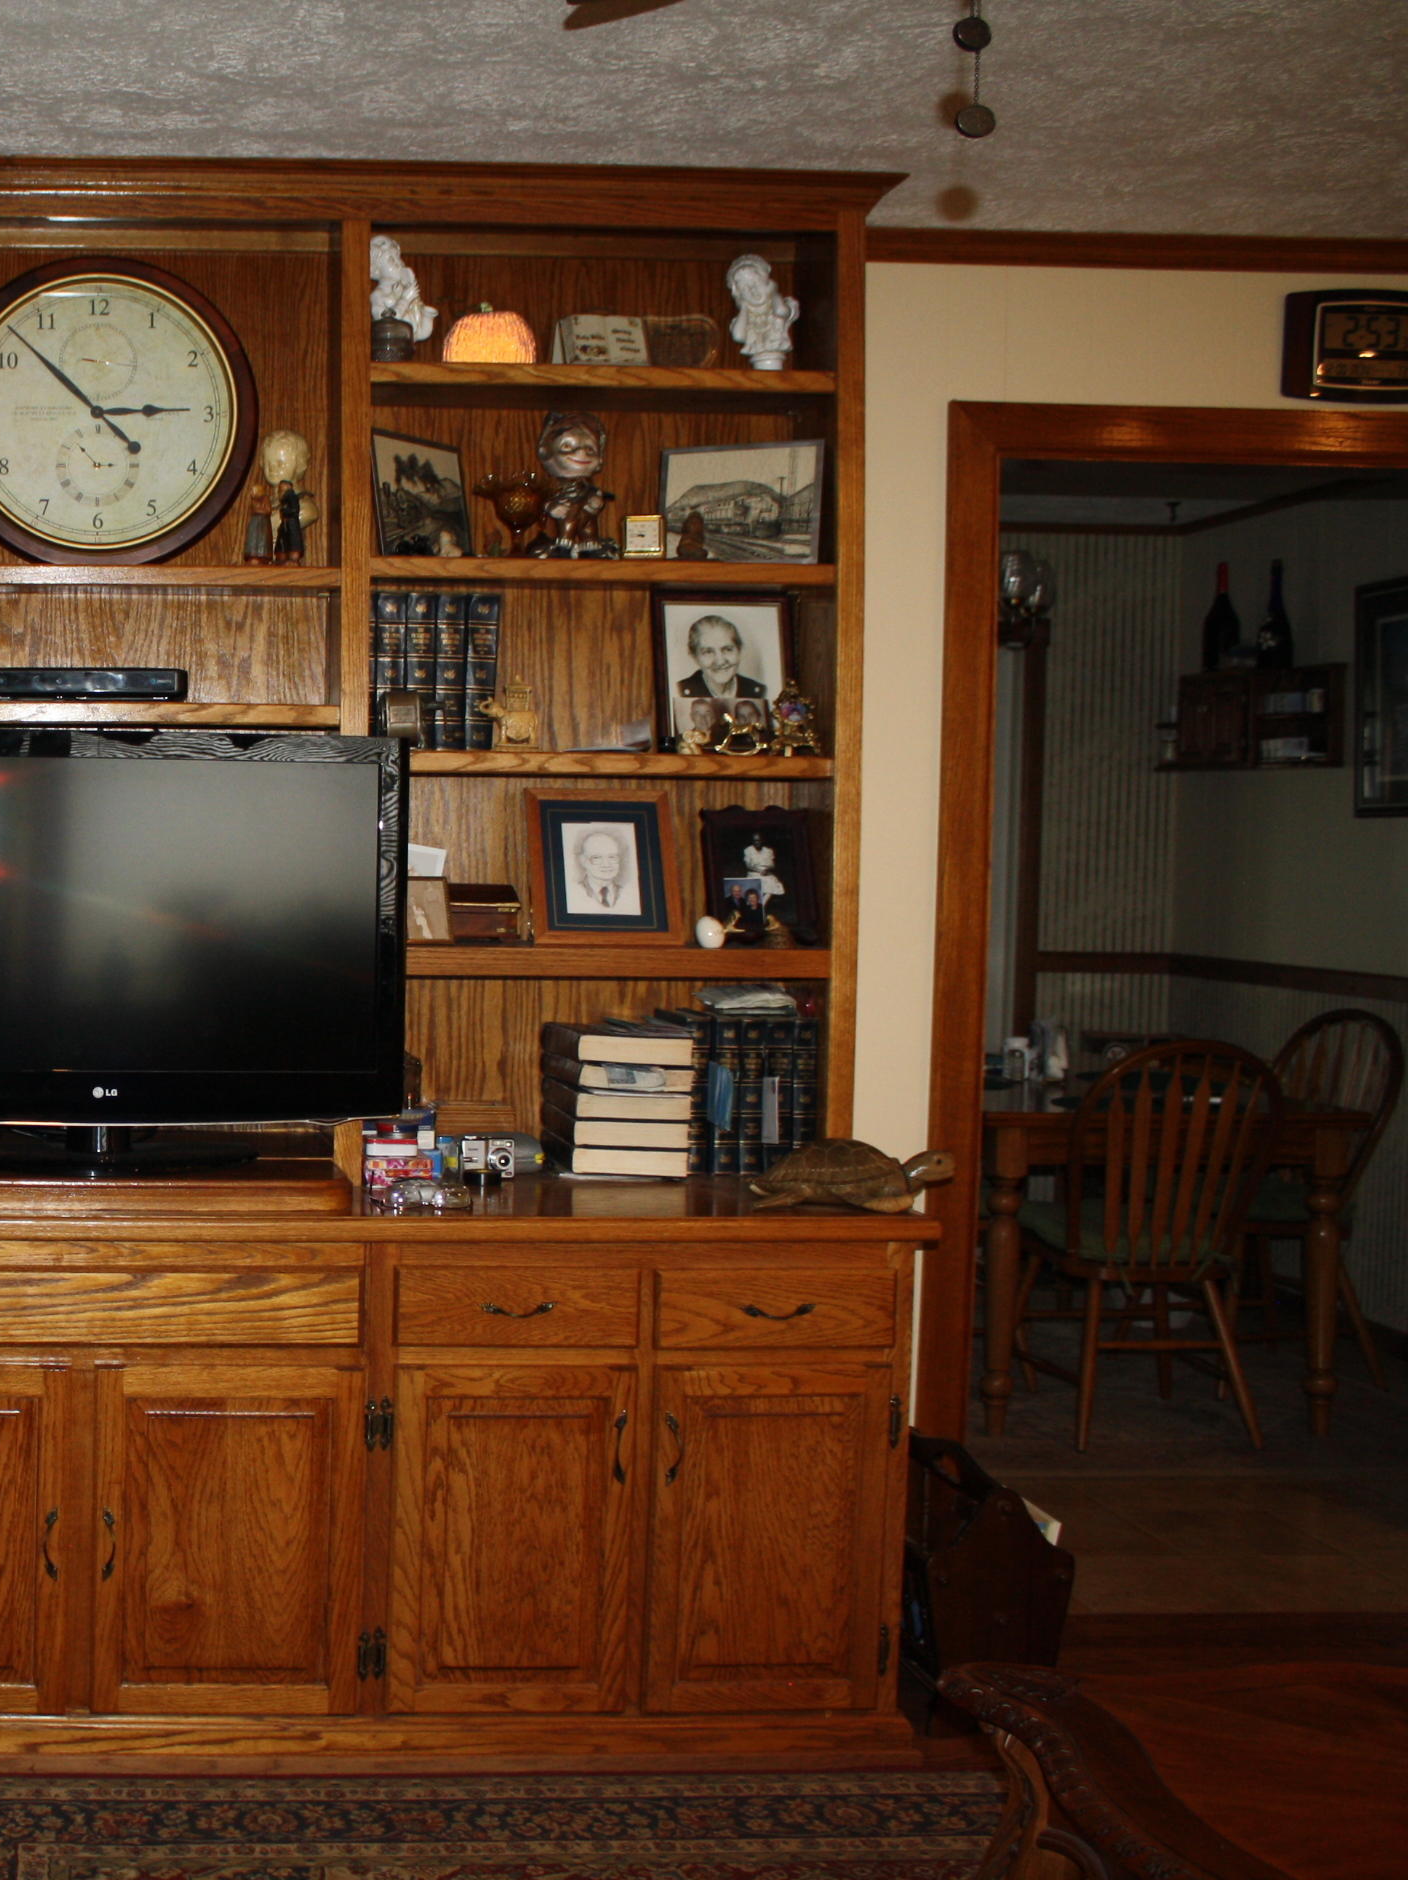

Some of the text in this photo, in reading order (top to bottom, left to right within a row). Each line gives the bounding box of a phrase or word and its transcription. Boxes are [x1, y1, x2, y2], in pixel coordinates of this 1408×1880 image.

[89, 299, 110, 316] 12
[35, 313, 56, 330] 11
[147, 312, 157, 329] 1
[187, 351, 199, 368] 2
[203, 405, 215, 423] 3
[186, 459, 198, 476] 4
[38, 499, 50, 516] 7
[146, 500, 157, 516] 5
[92, 512, 104, 530] 6
